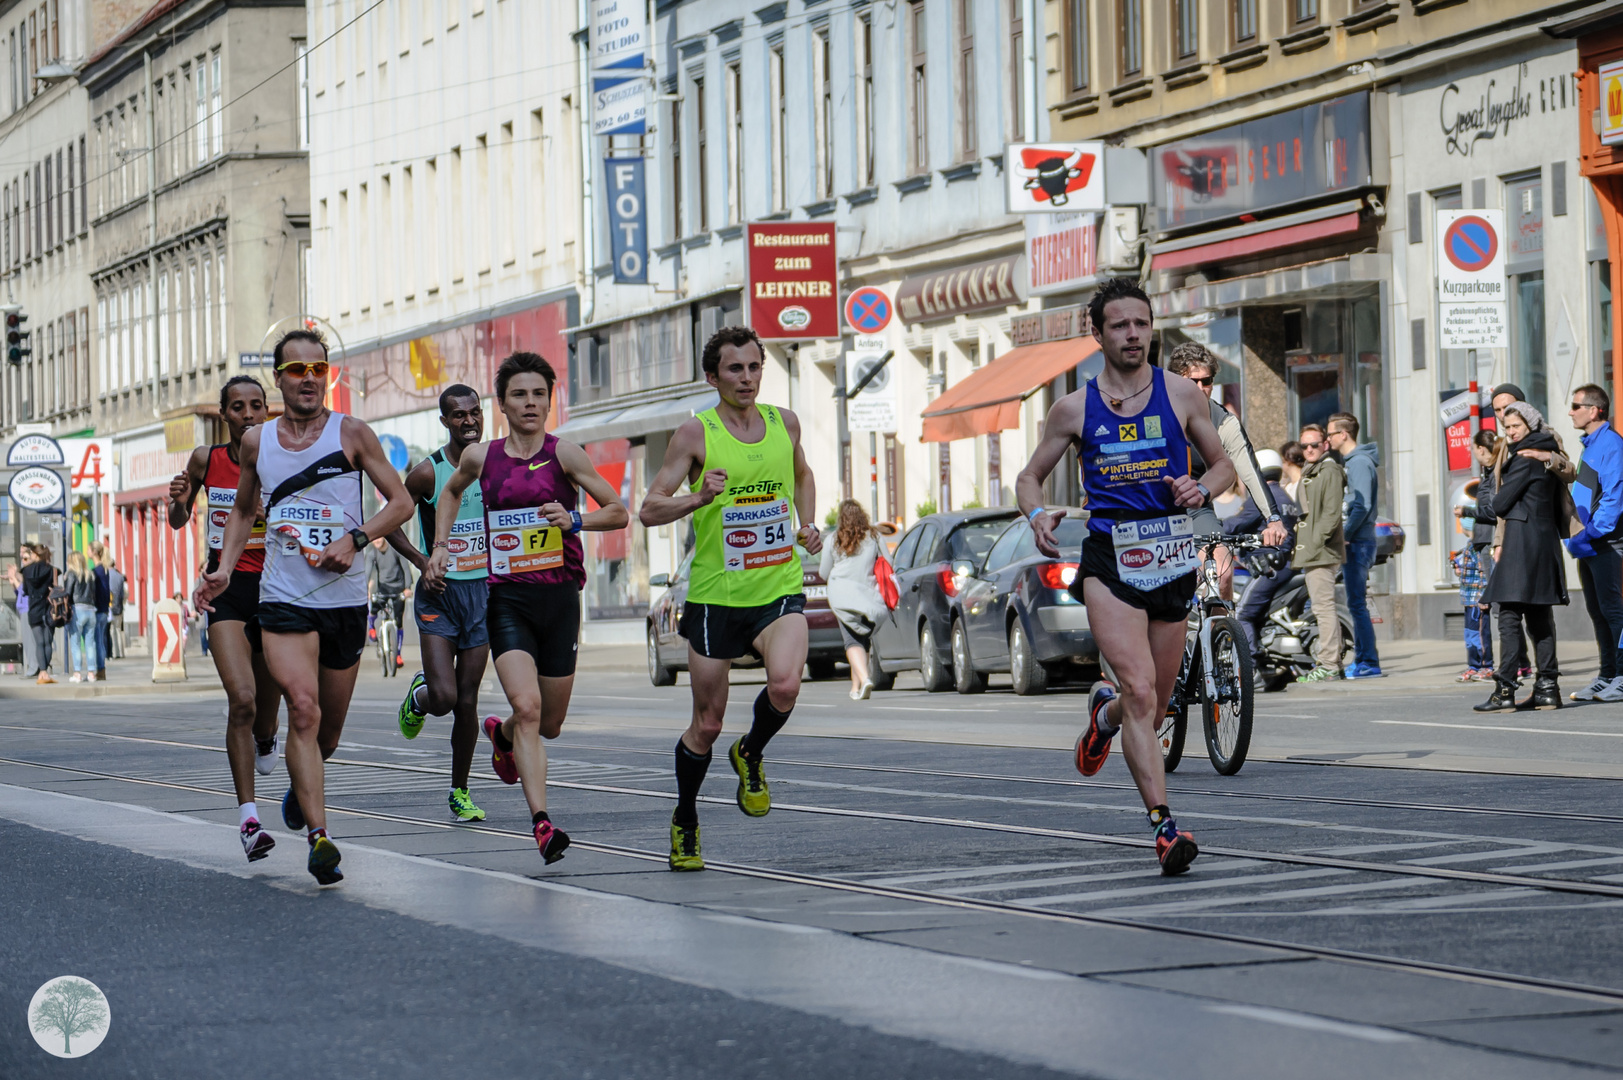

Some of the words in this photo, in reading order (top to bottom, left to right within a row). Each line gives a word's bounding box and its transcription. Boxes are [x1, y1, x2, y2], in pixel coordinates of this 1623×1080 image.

[597, 1, 617, 17] und
[598, 17, 629, 36] FOTO
[598, 32, 640, 54] STUDIO
[1540, 72, 1576, 114] CENT
[595, 117, 614, 130] 892
[617, 112, 630, 122] 60
[634, 107, 646, 118] 50
[1207, 138, 1301, 193] FRISEUR
[615, 165, 642, 277] FOTO
[754, 232, 830, 247] Restaurant
[775, 257, 812, 271] zum
[755, 281, 832, 298] LEITNER
[921, 262, 1012, 314] LEITNER
[1443, 279, 1501, 296] Kurzparkzone
[858, 338, 884, 349] Anfang
[1448, 425, 1465, 437] Gut
[20, 437, 50, 449] AUTOBUS
[1451, 438, 1461, 447] zu
[1110, 458, 1169, 474] INTERSPORT
[16, 471, 57, 487] STRASSENBAHN
[1110, 470, 1160, 481] PACHLEITNER
[729, 480, 783, 496] SPORTLER
[18, 493, 55, 505] HALTESTELLE
[210, 492, 236, 502] SPARK
[735, 495, 775, 504] ATHESIA
[42, 516, 50, 524] 52
[280, 507, 320, 520] ERSTE
[498, 511, 535, 526] ERSTE
[725, 505, 781, 521] SPARKASSE
[451, 521, 482, 533] ERSTE
[765, 523, 786, 545] 54
[1140, 522, 1167, 535] OMV
[309, 528, 332, 547] 53
[470, 536, 487, 552] 78
[494, 537, 519, 548] Hervis
[530, 529, 549, 549] F7
[729, 534, 756, 545] Hervis
[532, 555, 562, 565] ENERGIE
[1122, 552, 1152, 563] Hervis
[1155, 540, 1195, 565] 24412
